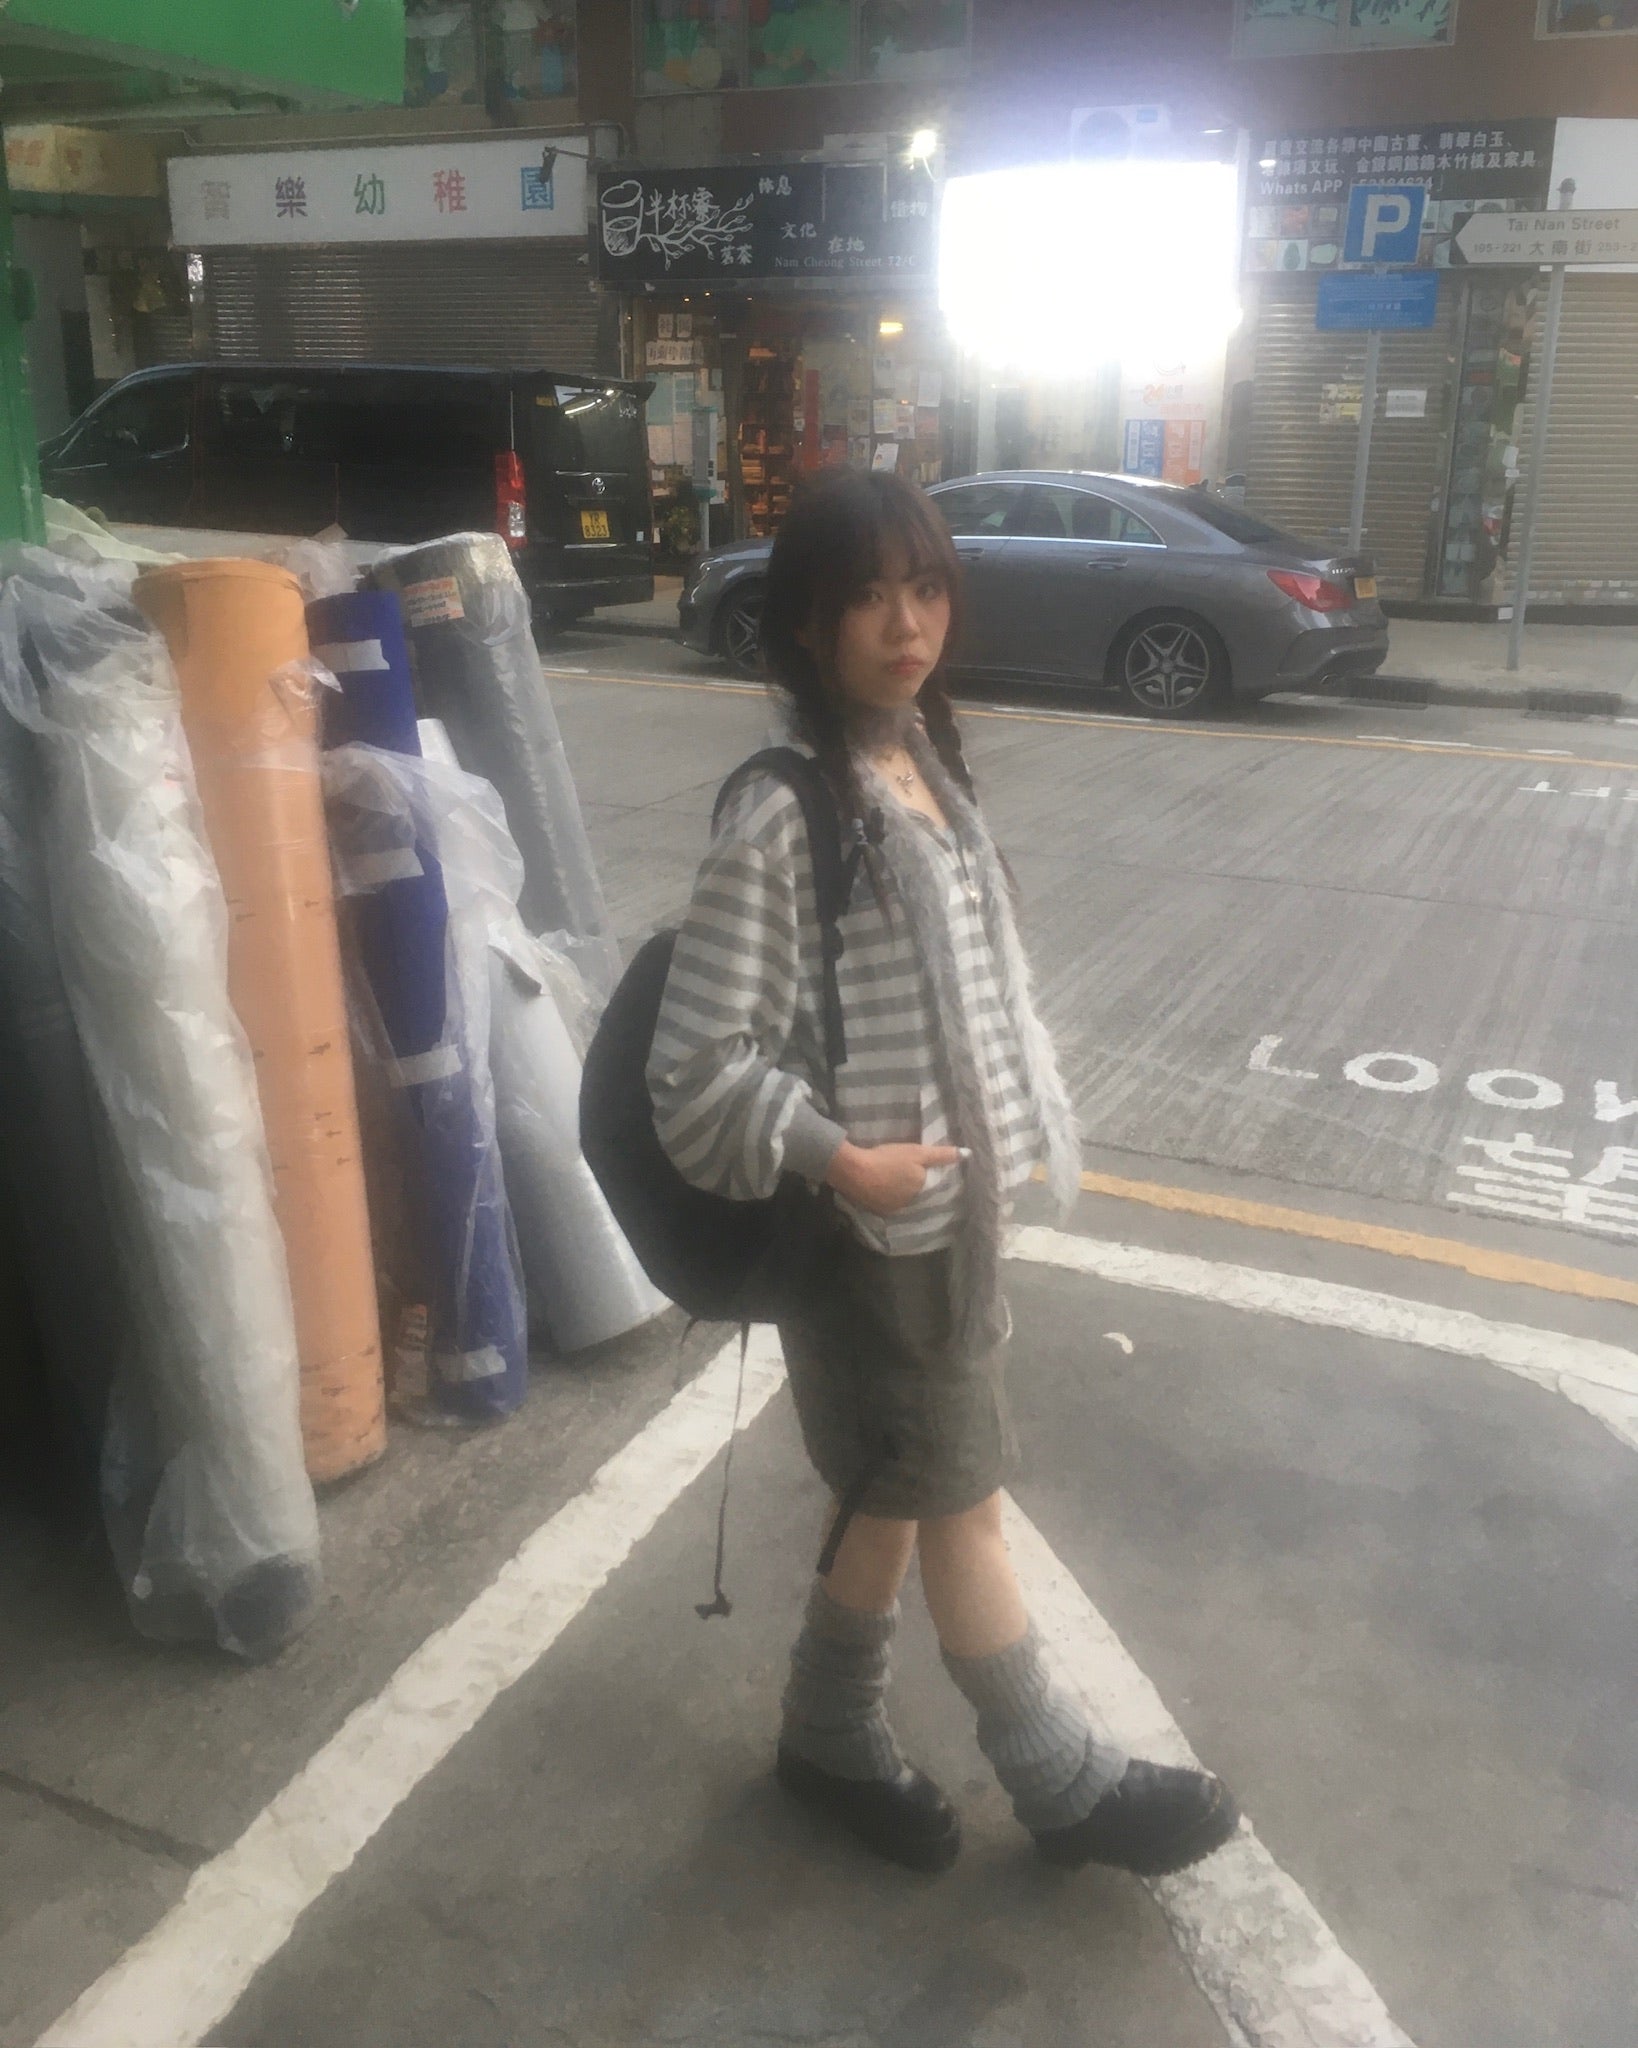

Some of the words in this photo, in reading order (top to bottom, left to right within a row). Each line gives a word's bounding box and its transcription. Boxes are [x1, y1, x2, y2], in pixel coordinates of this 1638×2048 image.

[758, 174, 793, 197] 休息
[1260, 180, 1308, 196] Whats
[1312, 179, 1343, 193] APP
[780, 222, 817, 240] 文化
[1361, 194, 1412, 258] P
[1507, 218, 1529, 231] Tai
[1534, 218, 1565, 231] Nan
[1571, 217, 1621, 231] Street
[827, 235, 865, 255] 在地
[1529, 239, 1592, 256] 大南街
[720, 244, 753, 266] 茗茶
[774, 256, 799, 267] Nam
[803, 256, 845, 269] Cheong
[849, 256, 882, 267] Street
[584, 524, 608, 537] 8323
